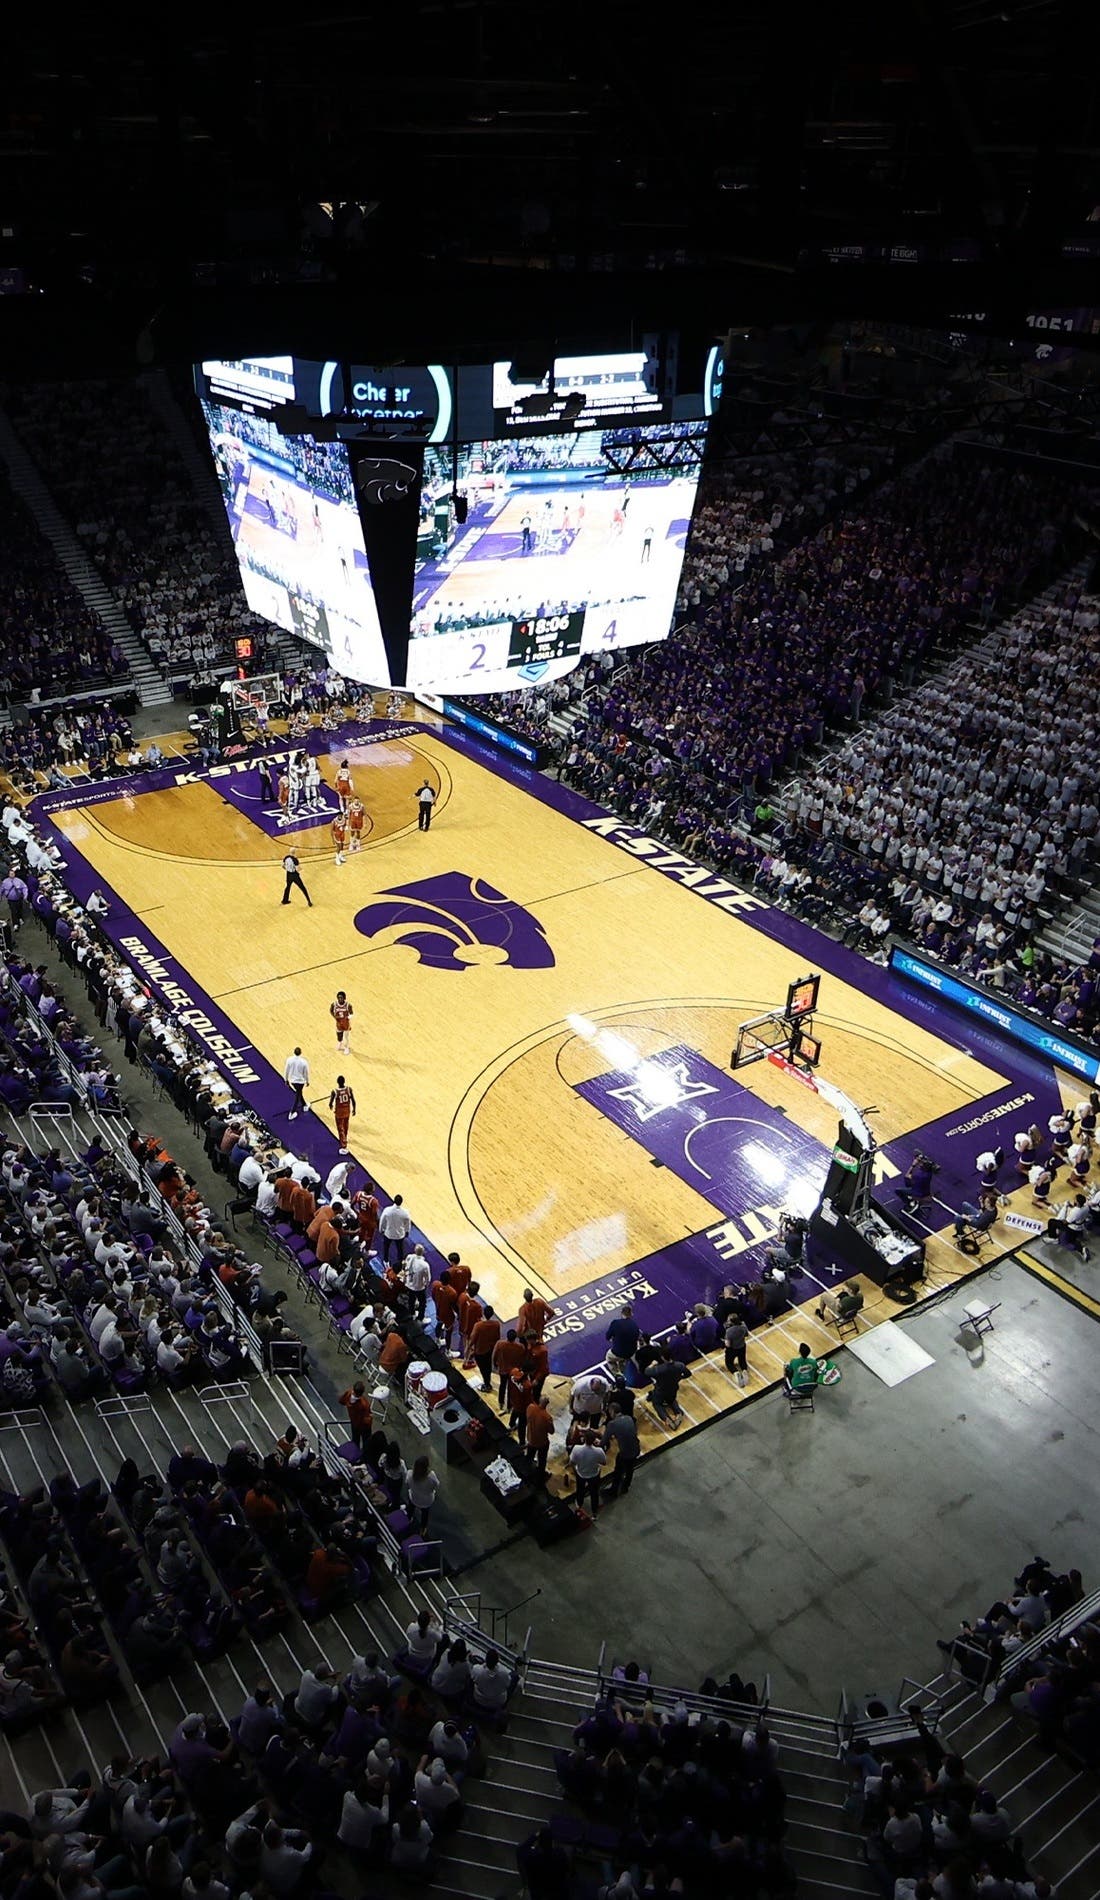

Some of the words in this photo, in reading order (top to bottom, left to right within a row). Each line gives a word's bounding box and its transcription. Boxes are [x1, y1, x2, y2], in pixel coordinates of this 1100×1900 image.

[527, 614, 570, 636] 18:06
[602, 619, 618, 643] 4
[470, 643, 487, 670] 2
[580, 816, 771, 914] K-STATE
[119, 936, 195, 1007] BRAMLAGE
[182, 1008, 262, 1084] COLISEUM
[339, 1094, 349, 1104] 10
[360, 1201, 367, 1211] 2
[1005, 1215, 1042, 1231] DEFENSE
